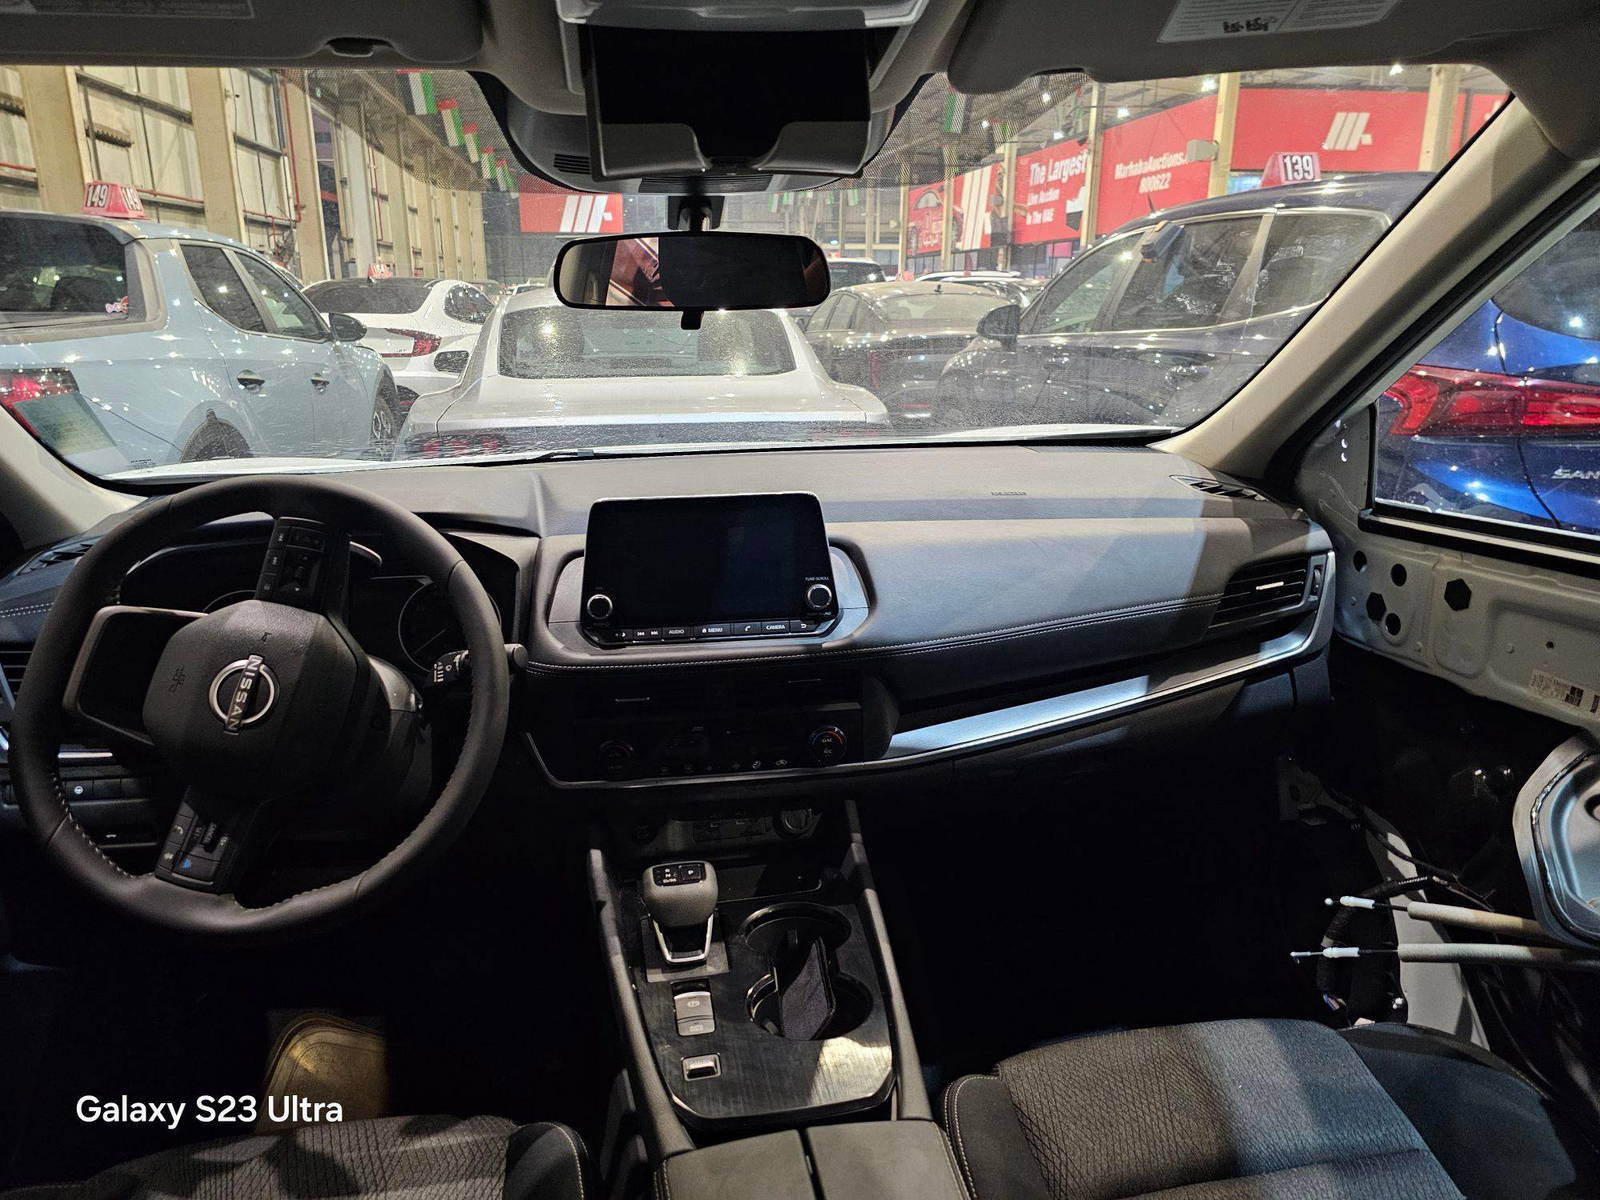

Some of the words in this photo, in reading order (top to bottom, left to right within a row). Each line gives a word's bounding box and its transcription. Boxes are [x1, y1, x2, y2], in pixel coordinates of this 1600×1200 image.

[1029, 162, 1046, 187] The
[1047, 149, 1088, 183] Largest
[1283, 154, 1315, 181] 139
[86, 184, 109, 208] 149
[765, 623, 786, 631] CAMERA
[223, 654, 264, 736] NISSAN
